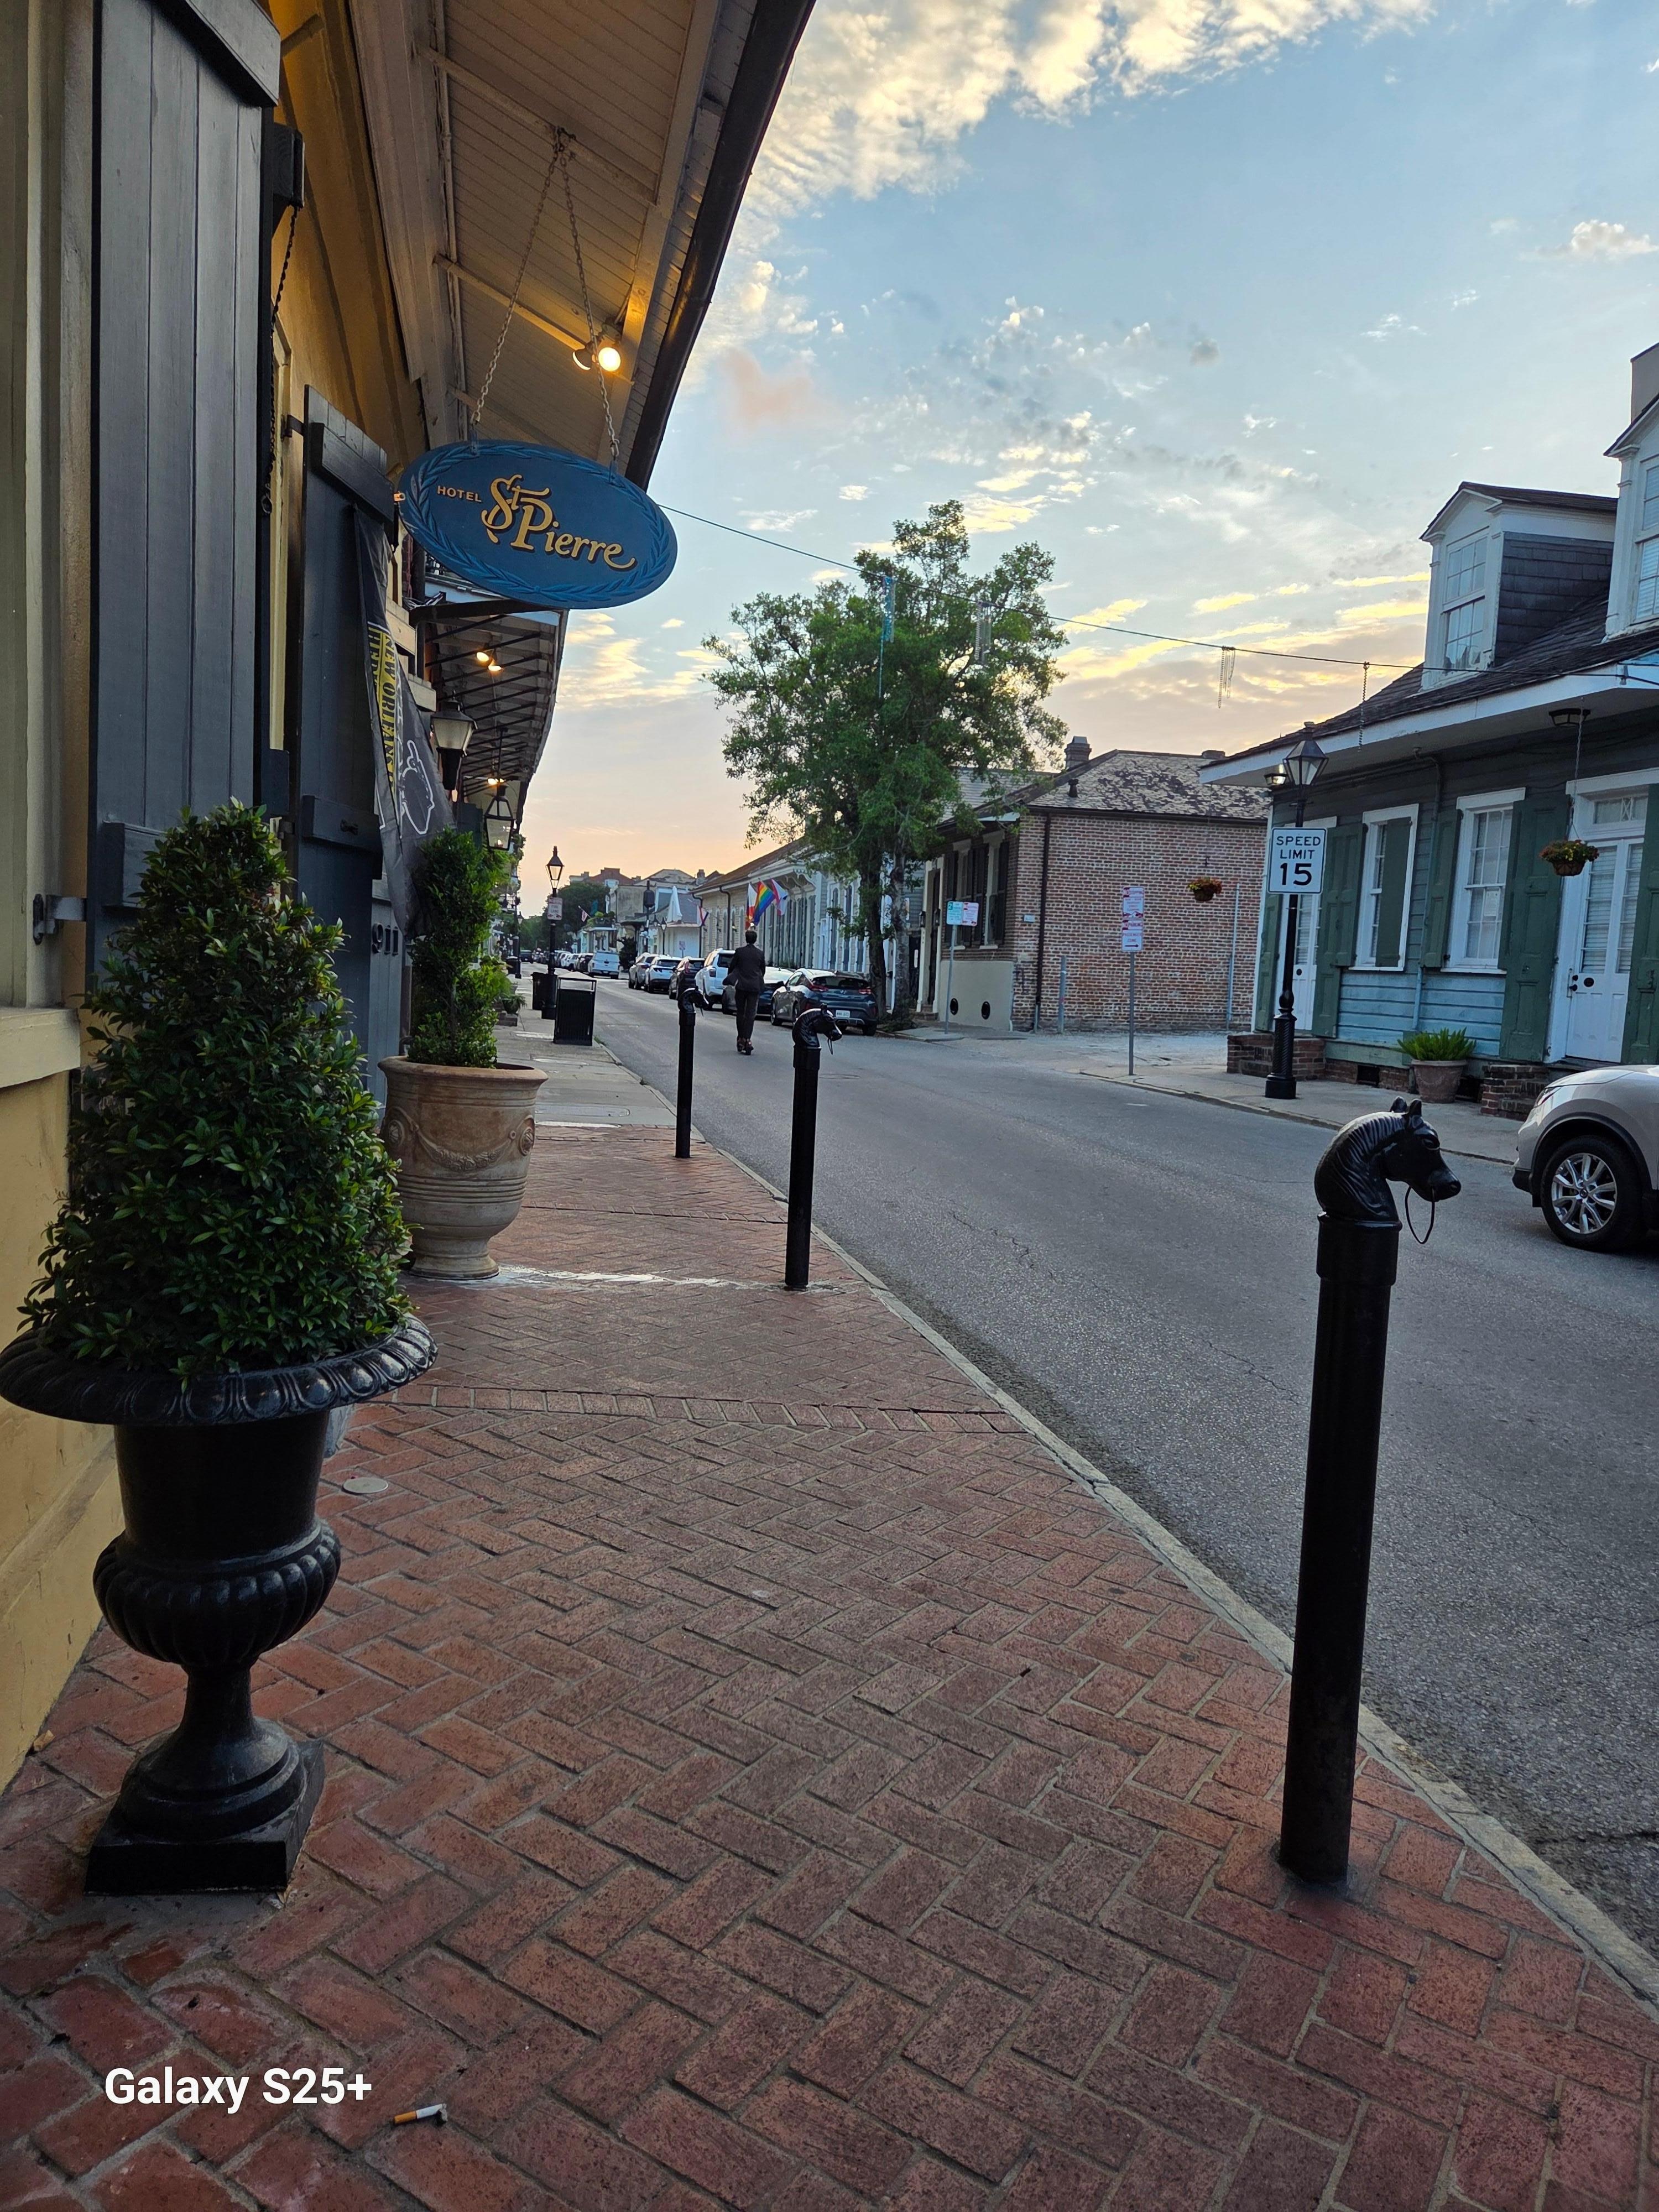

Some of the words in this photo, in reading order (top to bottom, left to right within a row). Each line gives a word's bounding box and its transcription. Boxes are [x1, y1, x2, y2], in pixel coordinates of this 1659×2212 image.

[437, 484, 483, 503] HOTEL
[510, 497, 637, 570] Pierre
[384, 635, 396, 681] NEW
[1276, 836, 1321, 846] SPEED
[1280, 849, 1315, 859] LIMIT
[1280, 863, 1312, 886] 15
[372, 923, 399, 957] 911
